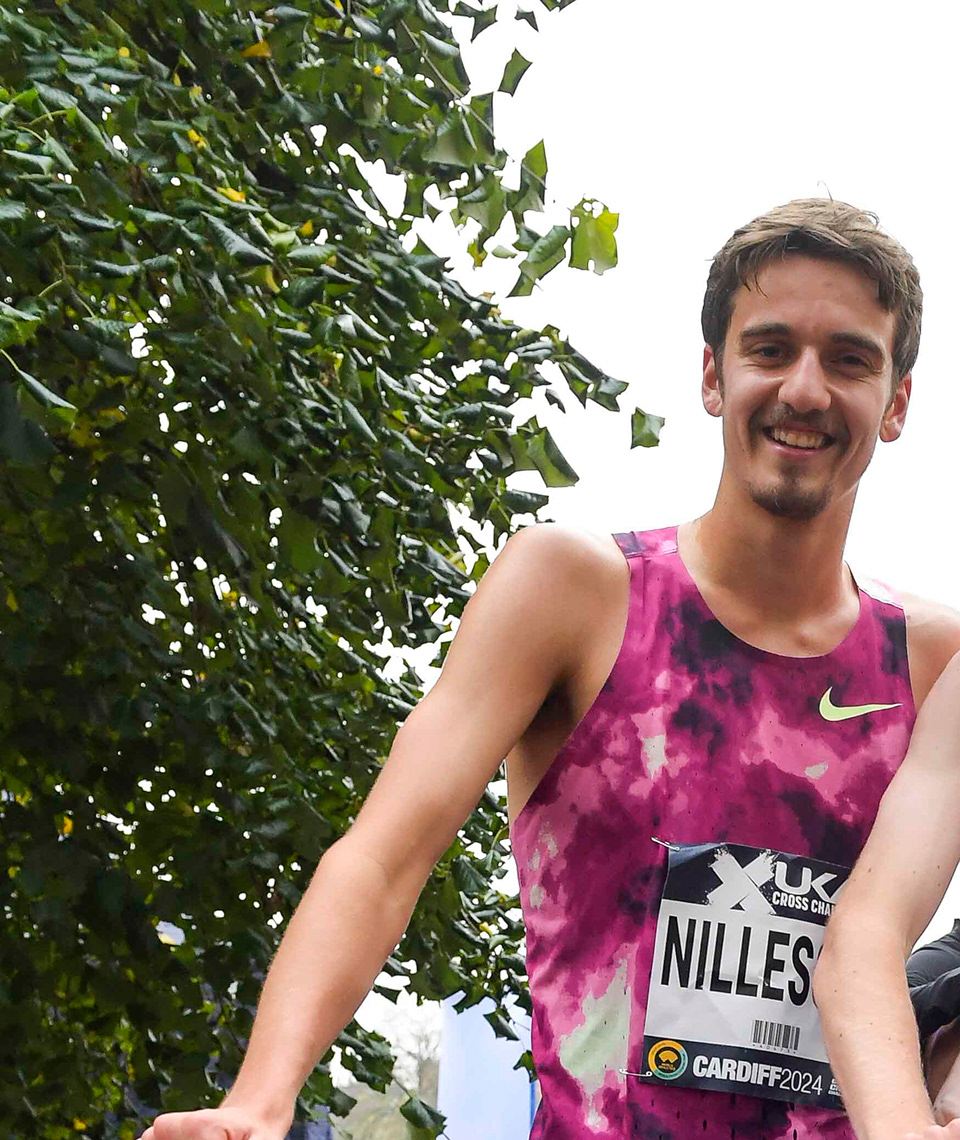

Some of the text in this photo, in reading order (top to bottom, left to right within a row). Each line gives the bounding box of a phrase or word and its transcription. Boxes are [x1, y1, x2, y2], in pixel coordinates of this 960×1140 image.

[771, 890, 809, 912] CROSS
[774, 861, 848, 904] UK
[660, 915, 823, 1009] NILLES
